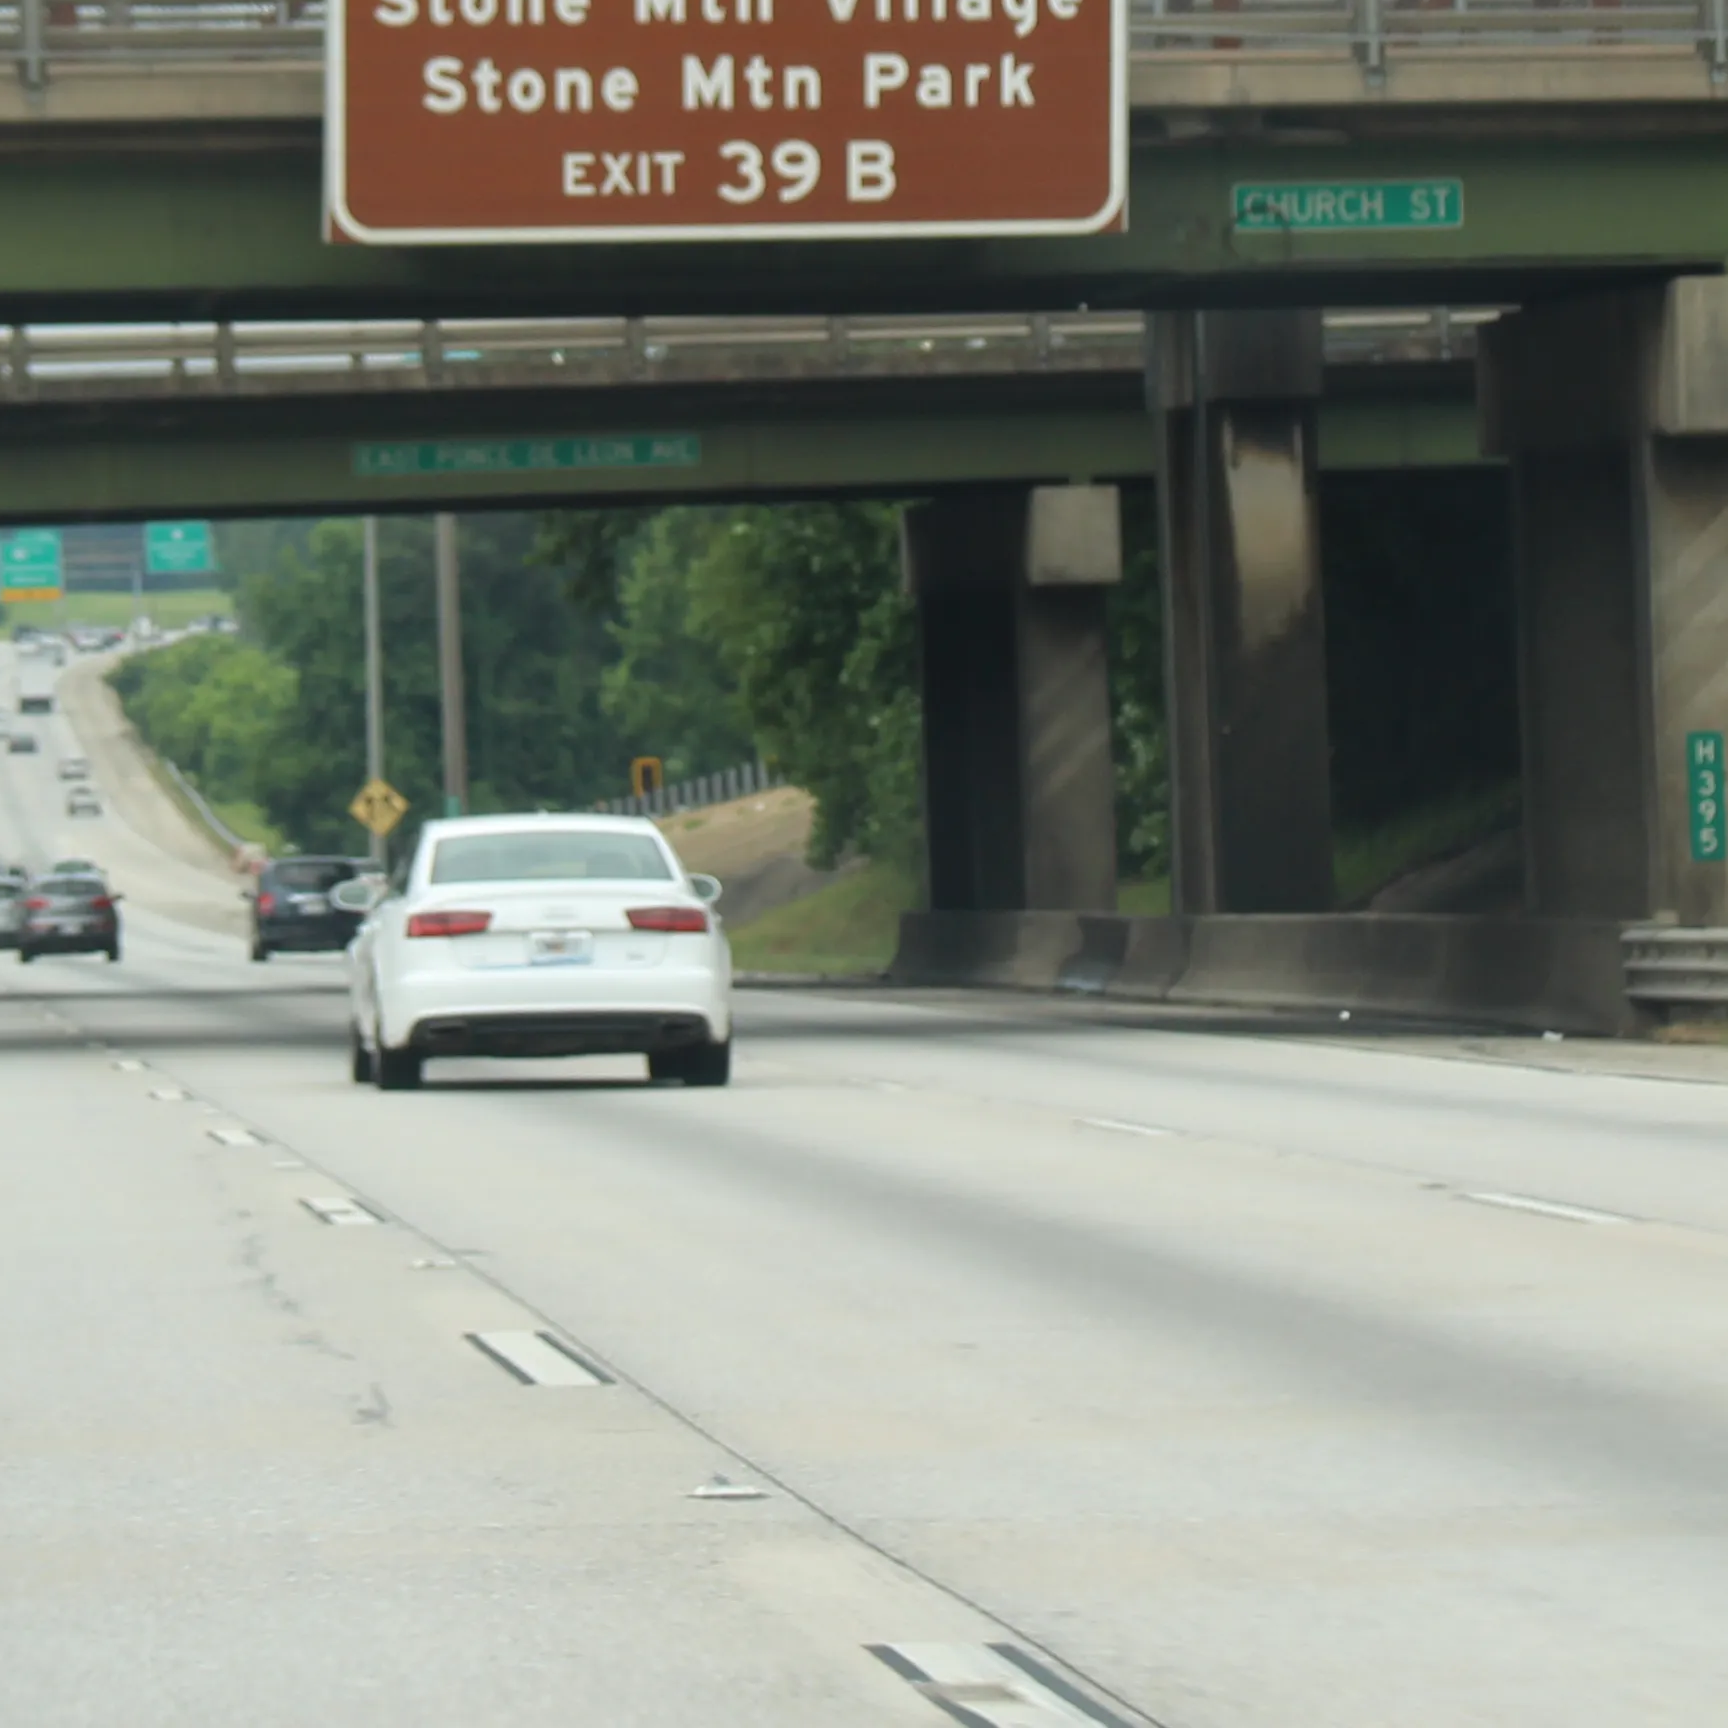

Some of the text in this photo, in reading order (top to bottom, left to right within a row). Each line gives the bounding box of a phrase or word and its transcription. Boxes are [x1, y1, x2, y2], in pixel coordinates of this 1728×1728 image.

[423, 53, 1036, 114] Stone Mtn Park
[563, 140, 897, 204] EXIT 39 B
[1243, 186, 1452, 223] CHURCH ST
